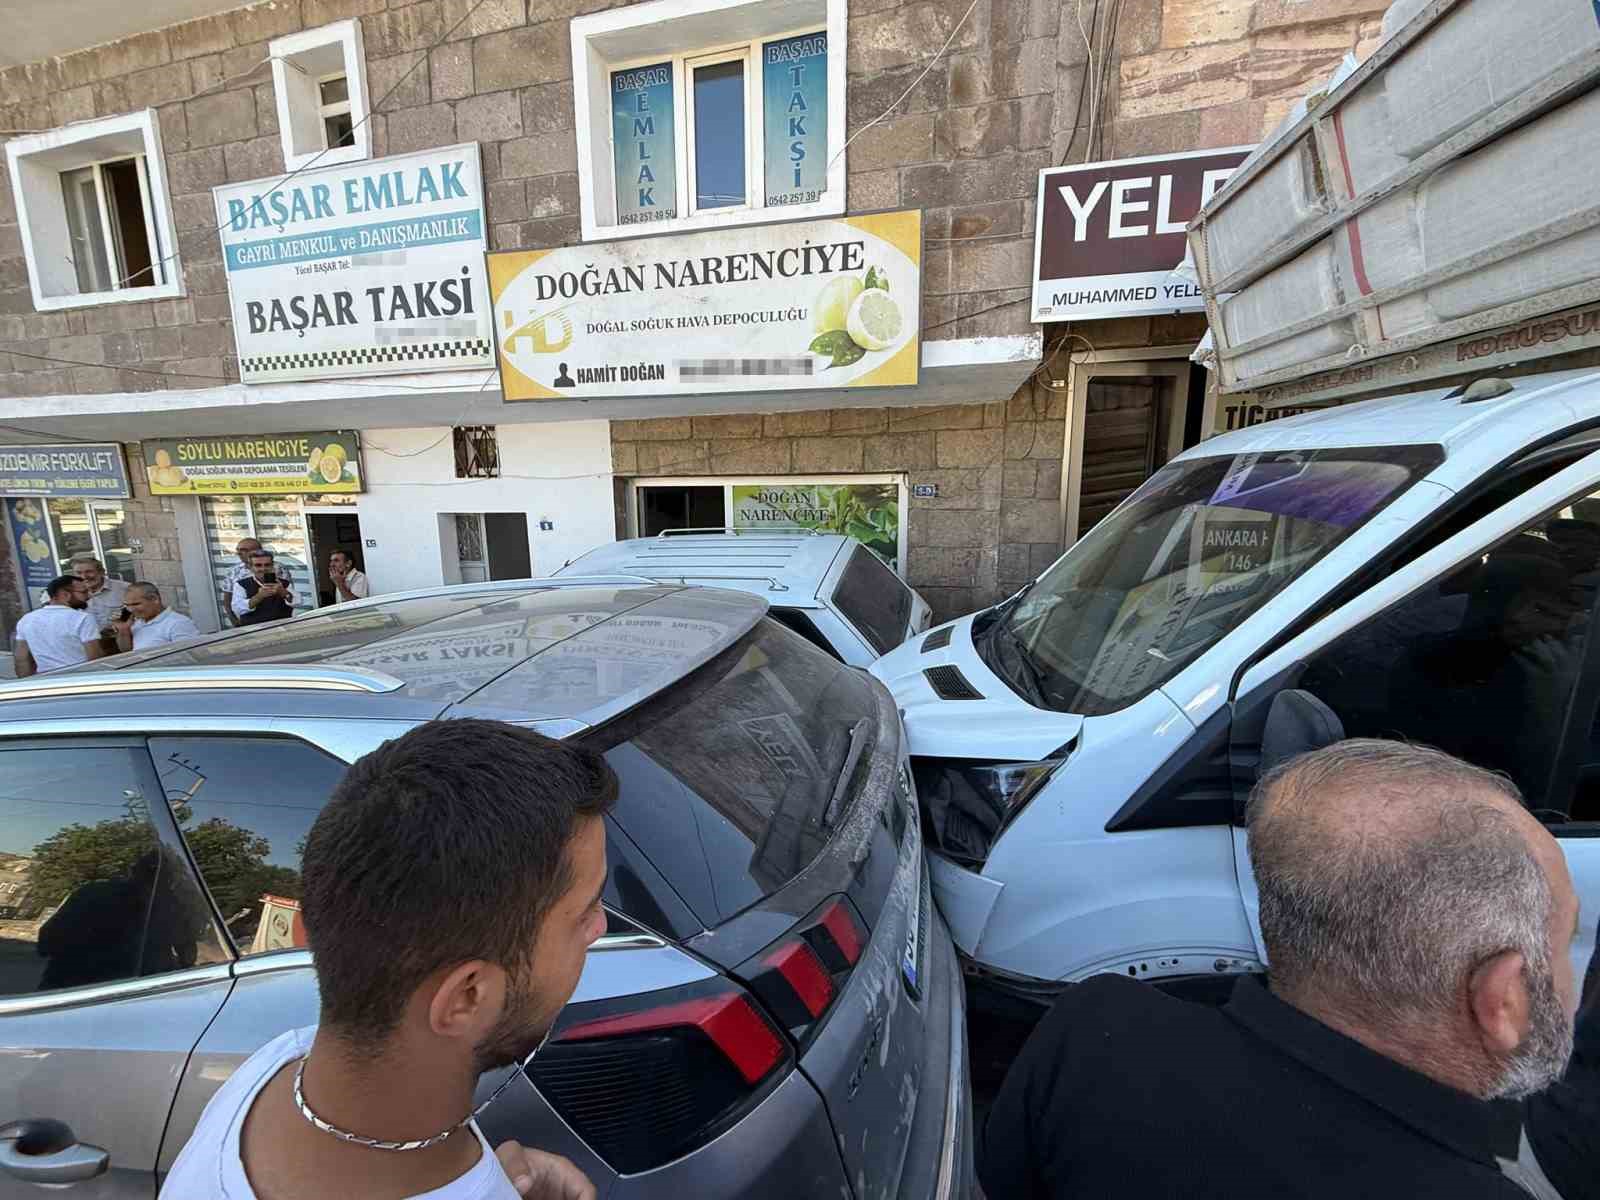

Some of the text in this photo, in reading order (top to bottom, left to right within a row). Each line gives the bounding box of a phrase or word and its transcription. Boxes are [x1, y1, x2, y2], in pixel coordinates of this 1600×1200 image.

[767, 37, 828, 63] BAŞAR
[616, 67, 669, 92] BAŞAR
[633, 92, 655, 207] EMLAK
[228, 161, 469, 233] BAŞAR EMLAK
[236, 243, 278, 265] GAYRİ
[280, 236, 337, 259] MENKUL
[340, 237, 356, 250] ve
[359, 217, 470, 248] DANIŞMANLIK
[534, 239, 866, 301] DOĞAN NARENCİYE
[246, 291, 358, 338] BAŞAR
[366, 265, 475, 320] TAKSİ
[1051, 286, 1158, 307] MUHAMMED
[586, 307, 809, 335] DOĞAL SOĞUK HAVA DEPOCULUĞU
[576, 363, 618, 385] HAMİT
[620, 361, 666, 383] DOĞAN
[51, 452, 113, 471] FORKLİFT
[177, 438, 310, 461] SÖYLU NARENCİYE
[1205, 530, 1259, 546] ANKARA
[1230, 554, 1251, 571] 146
